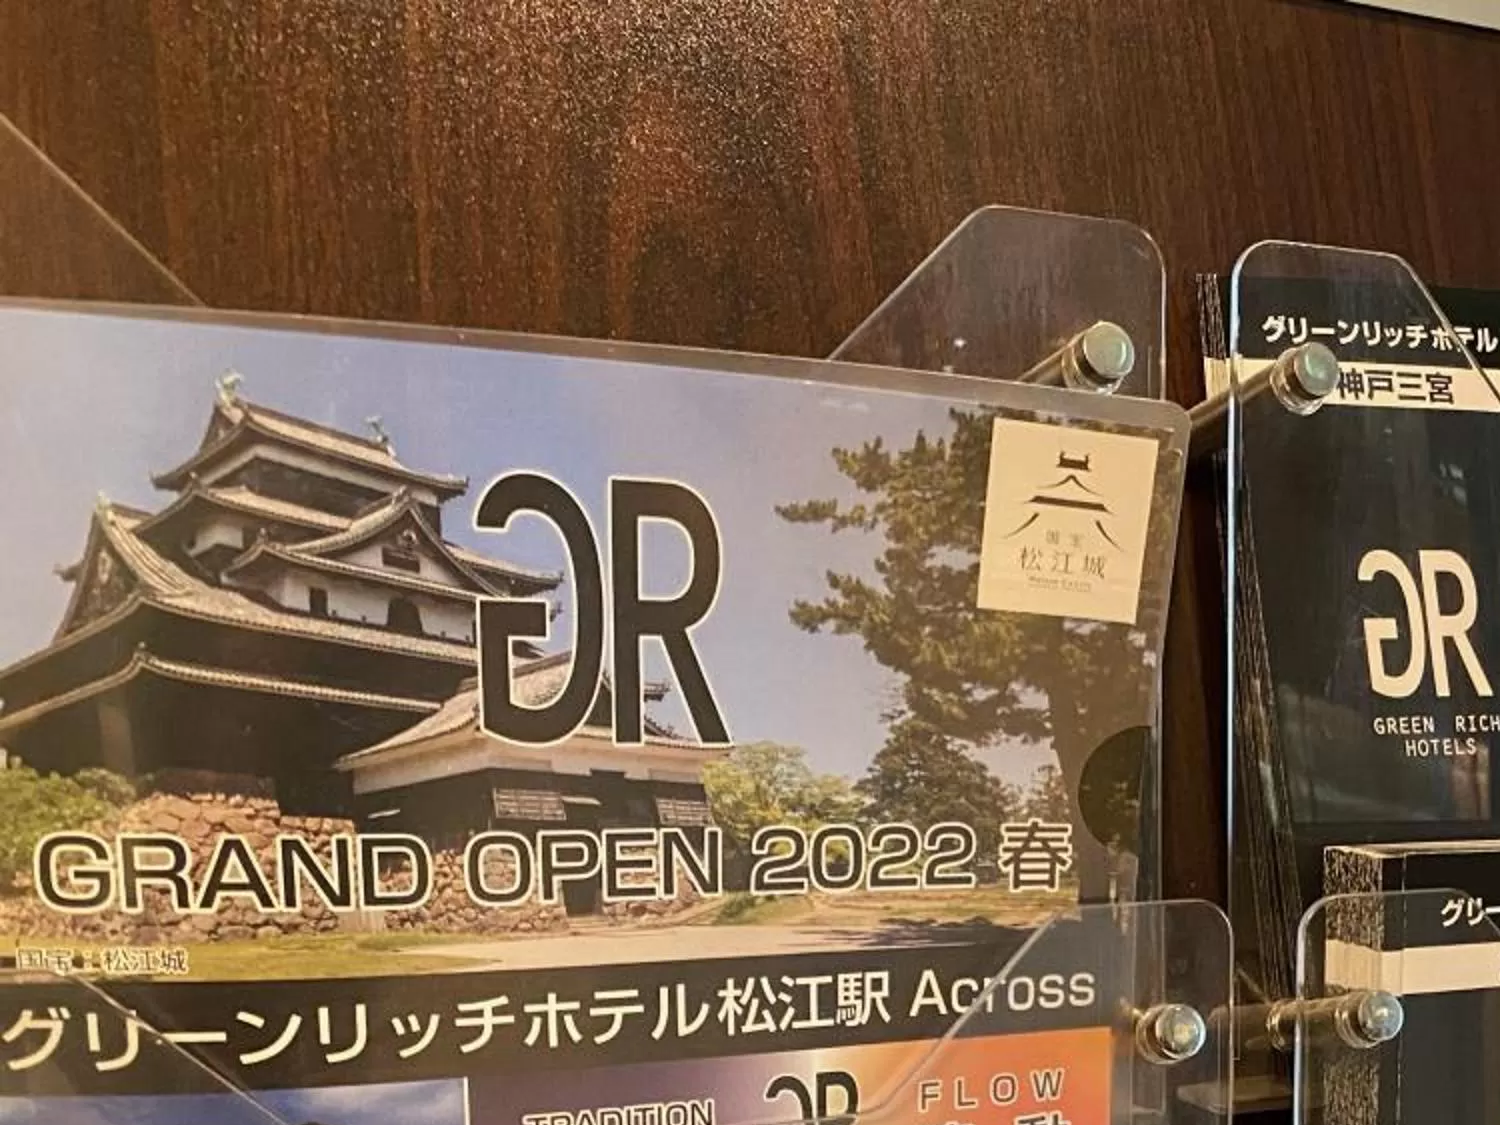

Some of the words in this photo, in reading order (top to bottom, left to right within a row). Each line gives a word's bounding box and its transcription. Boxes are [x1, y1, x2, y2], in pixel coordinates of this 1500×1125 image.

[1262, 315, 1499, 353] グリーンリッチホテル
[1337, 367, 1455, 405] 神戸三宮
[1020, 544, 1105, 579] 松江城
[1373, 716, 1435, 735] GREEN
[1455, 714, 1500, 732] RICH
[1405, 737, 1477, 757] HOTELS
[33, 832, 433, 912] GRAND
[465, 826, 720, 905] OPEN
[750, 823, 976, 898] 2022
[1000, 818, 1073, 893] 春
[909, 969, 1096, 1016] Across
[918, 1068, 1066, 1113] FLOW
